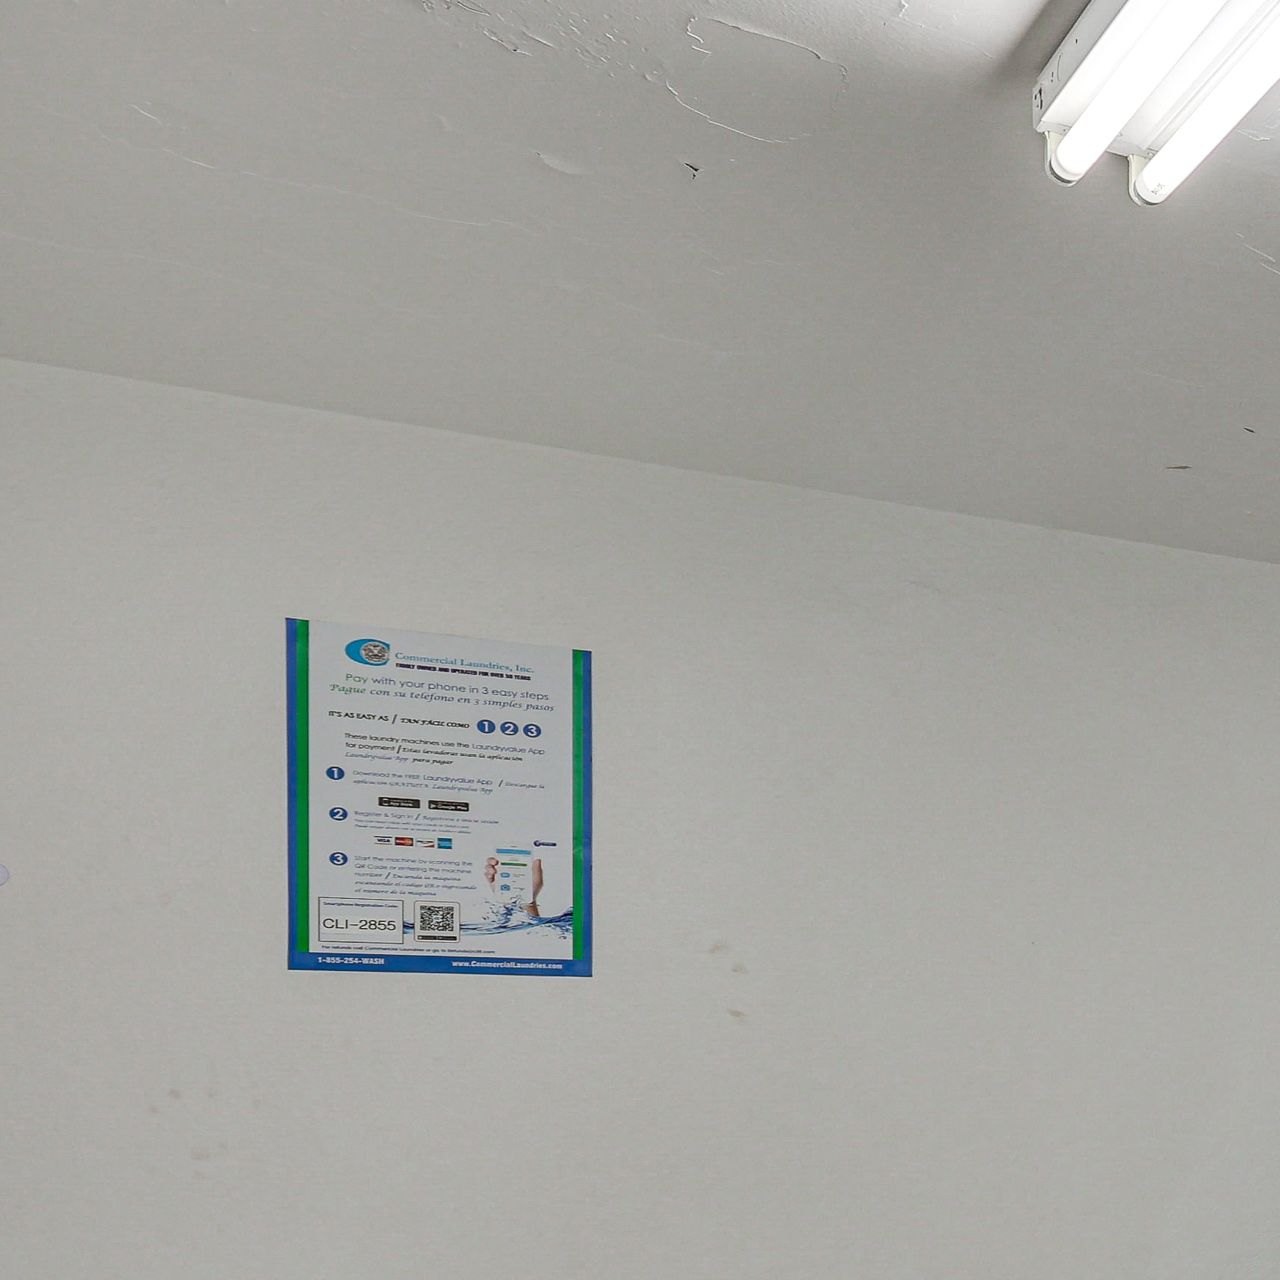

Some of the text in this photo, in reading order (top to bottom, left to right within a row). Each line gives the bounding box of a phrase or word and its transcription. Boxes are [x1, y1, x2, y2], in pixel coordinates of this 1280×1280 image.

[394, 652, 534, 673] Commercial Laundries, Inc.
[345, 673, 549, 701] Pay with your phone in 3 easy steps
[329, 684, 366, 694] Pague
[524, 702, 554, 712] pasos
[482, 721, 537, 737] 1 2 3
[333, 769, 338, 778] 1
[335, 809, 343, 819] 2
[335, 854, 343, 864] 3
[322, 918, 396, 930] CLI-2855
